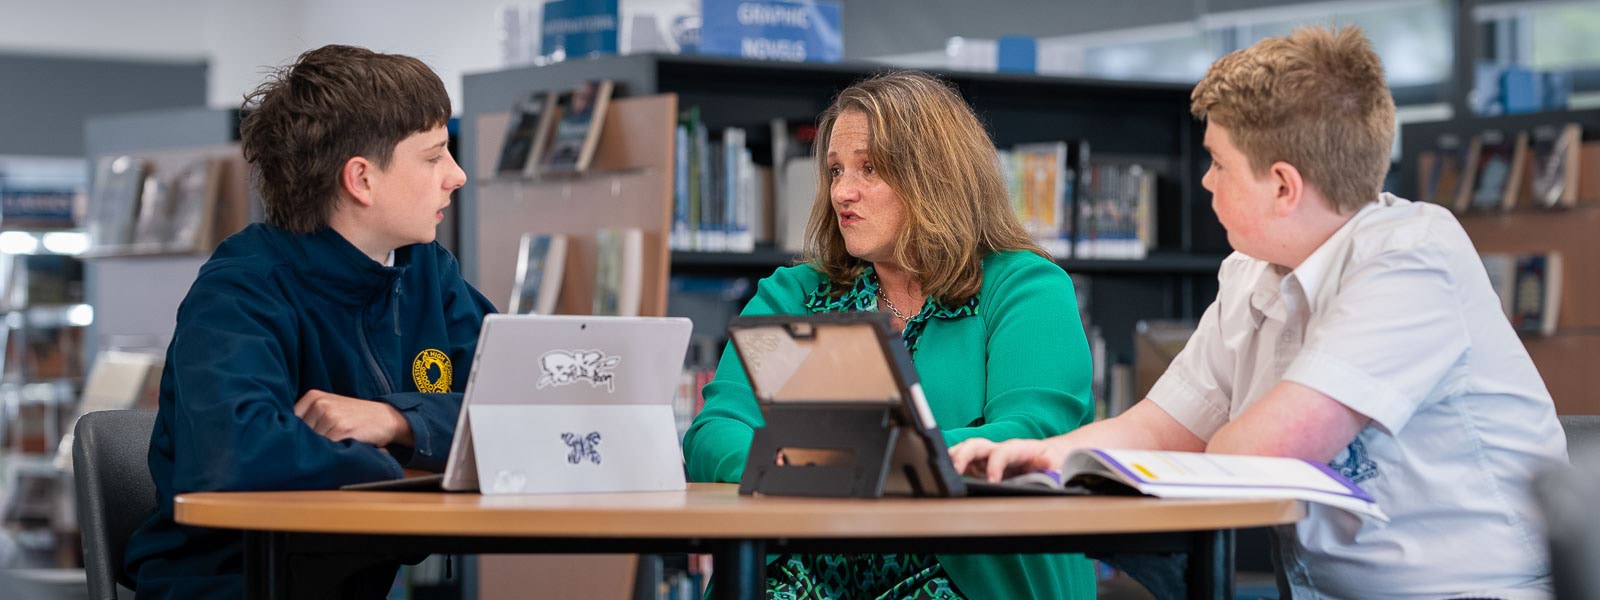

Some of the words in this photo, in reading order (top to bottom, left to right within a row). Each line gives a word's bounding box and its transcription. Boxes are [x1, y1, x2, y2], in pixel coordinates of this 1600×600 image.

[737, 3, 810, 29] GRAPHIC
[741, 38, 807, 62] NOVELS
[415, 359, 427, 393] ANKSTON
[430, 351, 446, 361] HIGH
